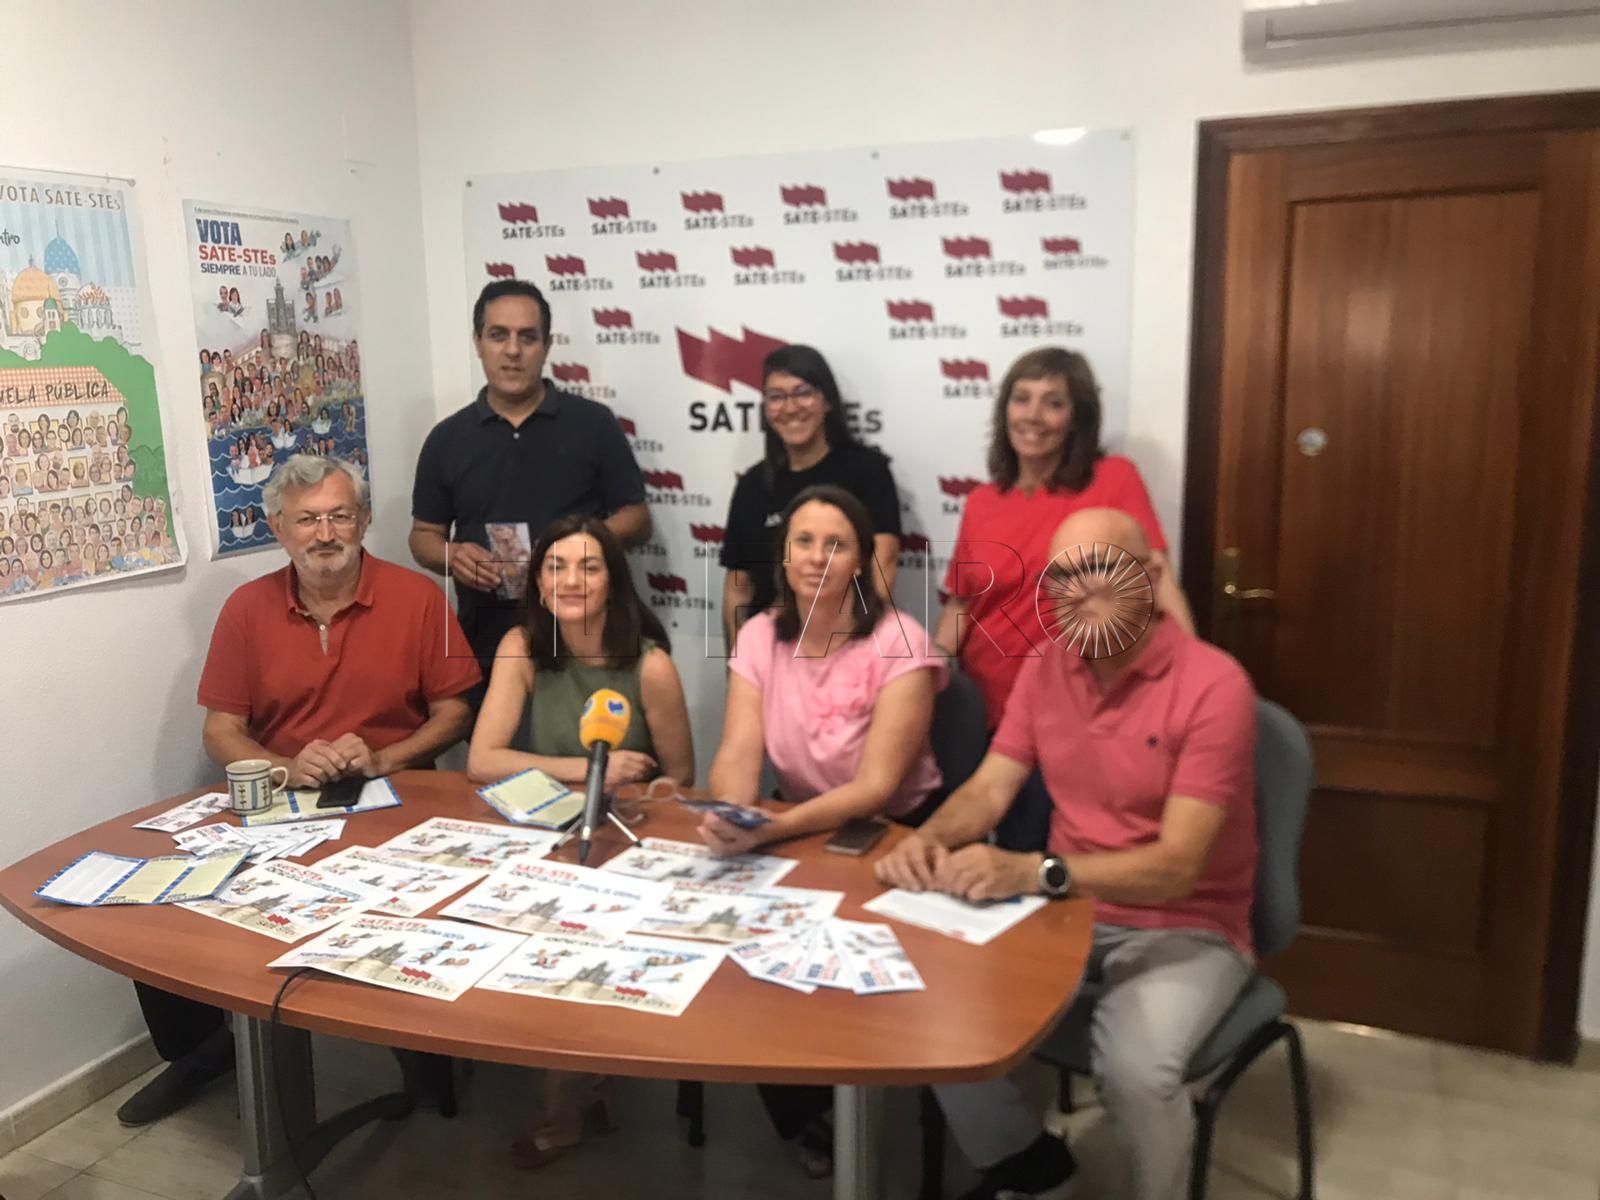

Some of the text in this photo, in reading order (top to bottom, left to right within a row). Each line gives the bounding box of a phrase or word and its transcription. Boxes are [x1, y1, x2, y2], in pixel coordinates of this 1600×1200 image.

[195, 218, 243, 246] VOTA
[502, 225, 566, 240] SATE-STEs
[591, 221, 657, 236] SATE-STEs
[198, 245, 277, 265] SATE-STEs
[200, 263, 241, 276] SIEMPRE
[242, 268, 248, 276] A
[249, 268, 258, 277] TU
[45, 380, 109, 401] PÚBLICA
